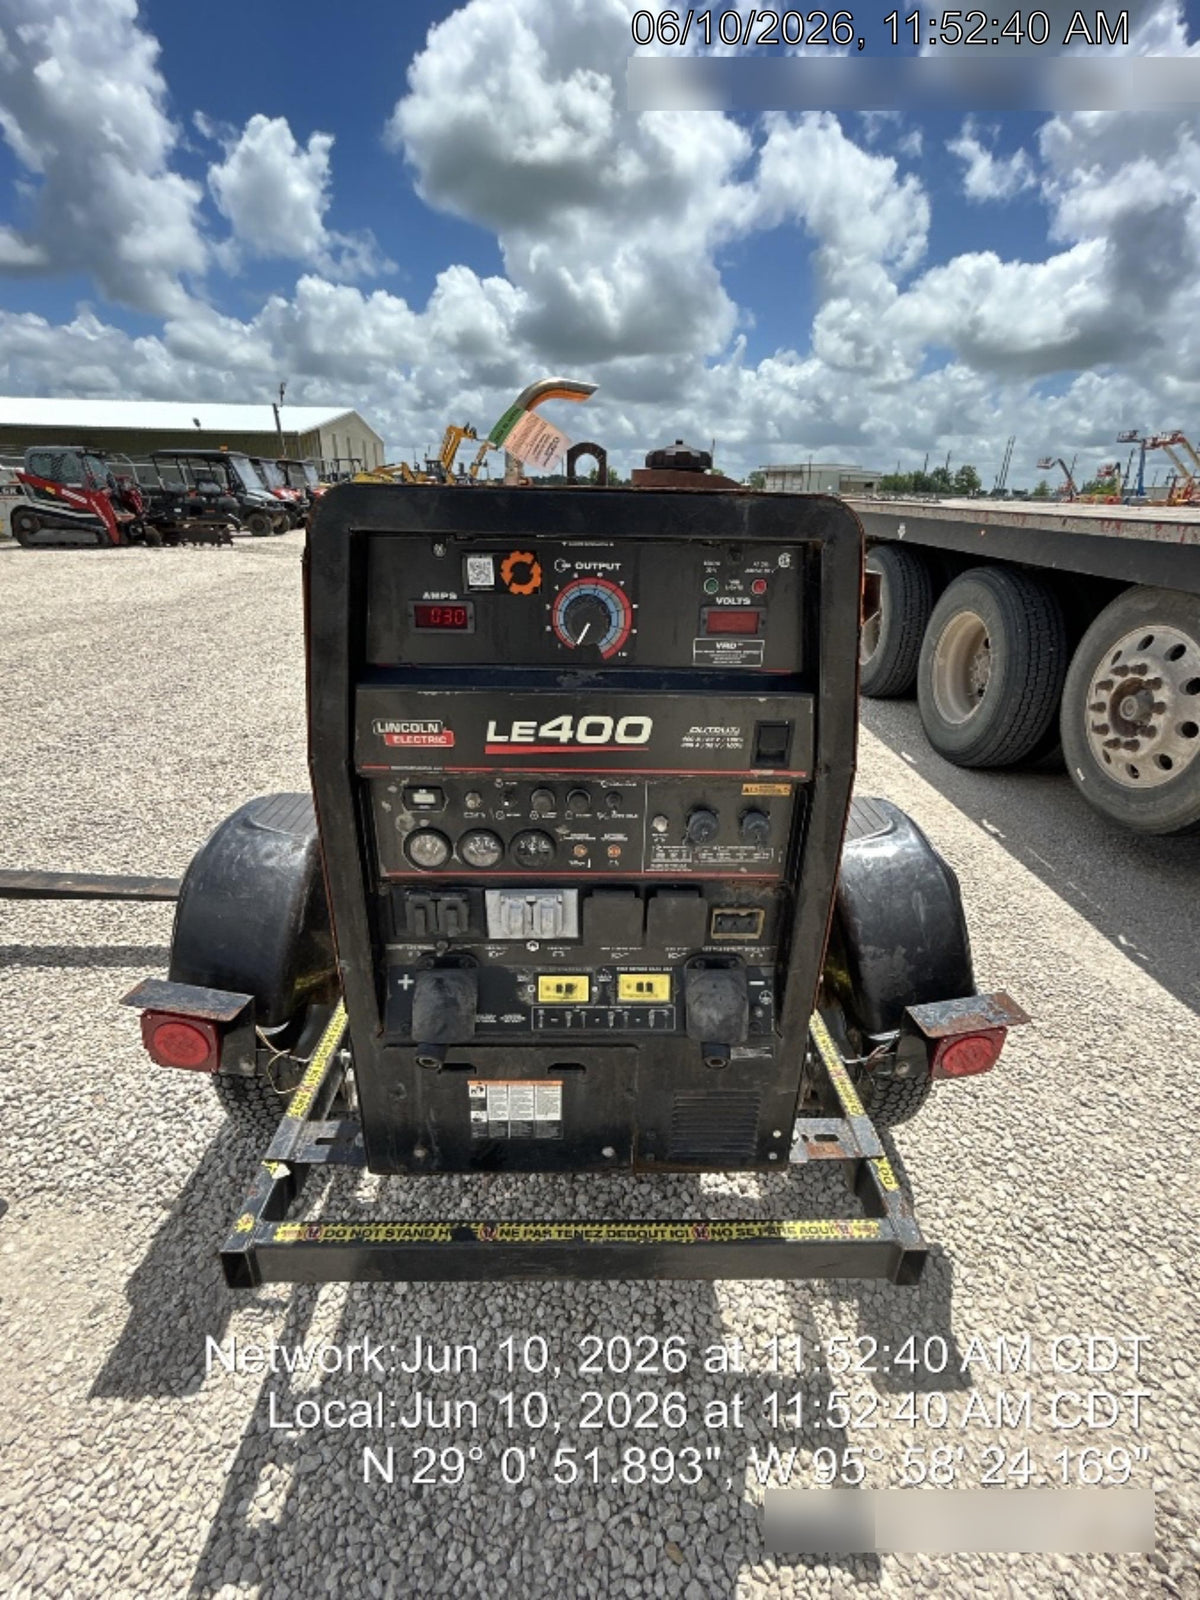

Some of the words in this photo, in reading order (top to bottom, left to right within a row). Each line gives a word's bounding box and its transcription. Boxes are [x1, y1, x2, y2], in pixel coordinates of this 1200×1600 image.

[575, 562, 622, 570] OUTPUT
[422, 592, 458, 600] AMPS
[716, 597, 751, 605] VOLTS
[431, 607, 465, 625] 030
[376, 722, 439, 734] LINCOLN
[486, 715, 653, 744] LE400
[392, 735, 447, 745] ELECTRIC
[323, 1228, 350, 1239] DO
[351, 1228, 383, 1239] NOT
[385, 1228, 435, 1239] STAND
[499, 1228, 520, 1239] NE
[523, 1228, 552, 1239] PAS
[606, 1228, 667, 1239] DEBOUT
[669, 1228, 689, 1238] ICI
[711, 1227, 733, 1238] NO
